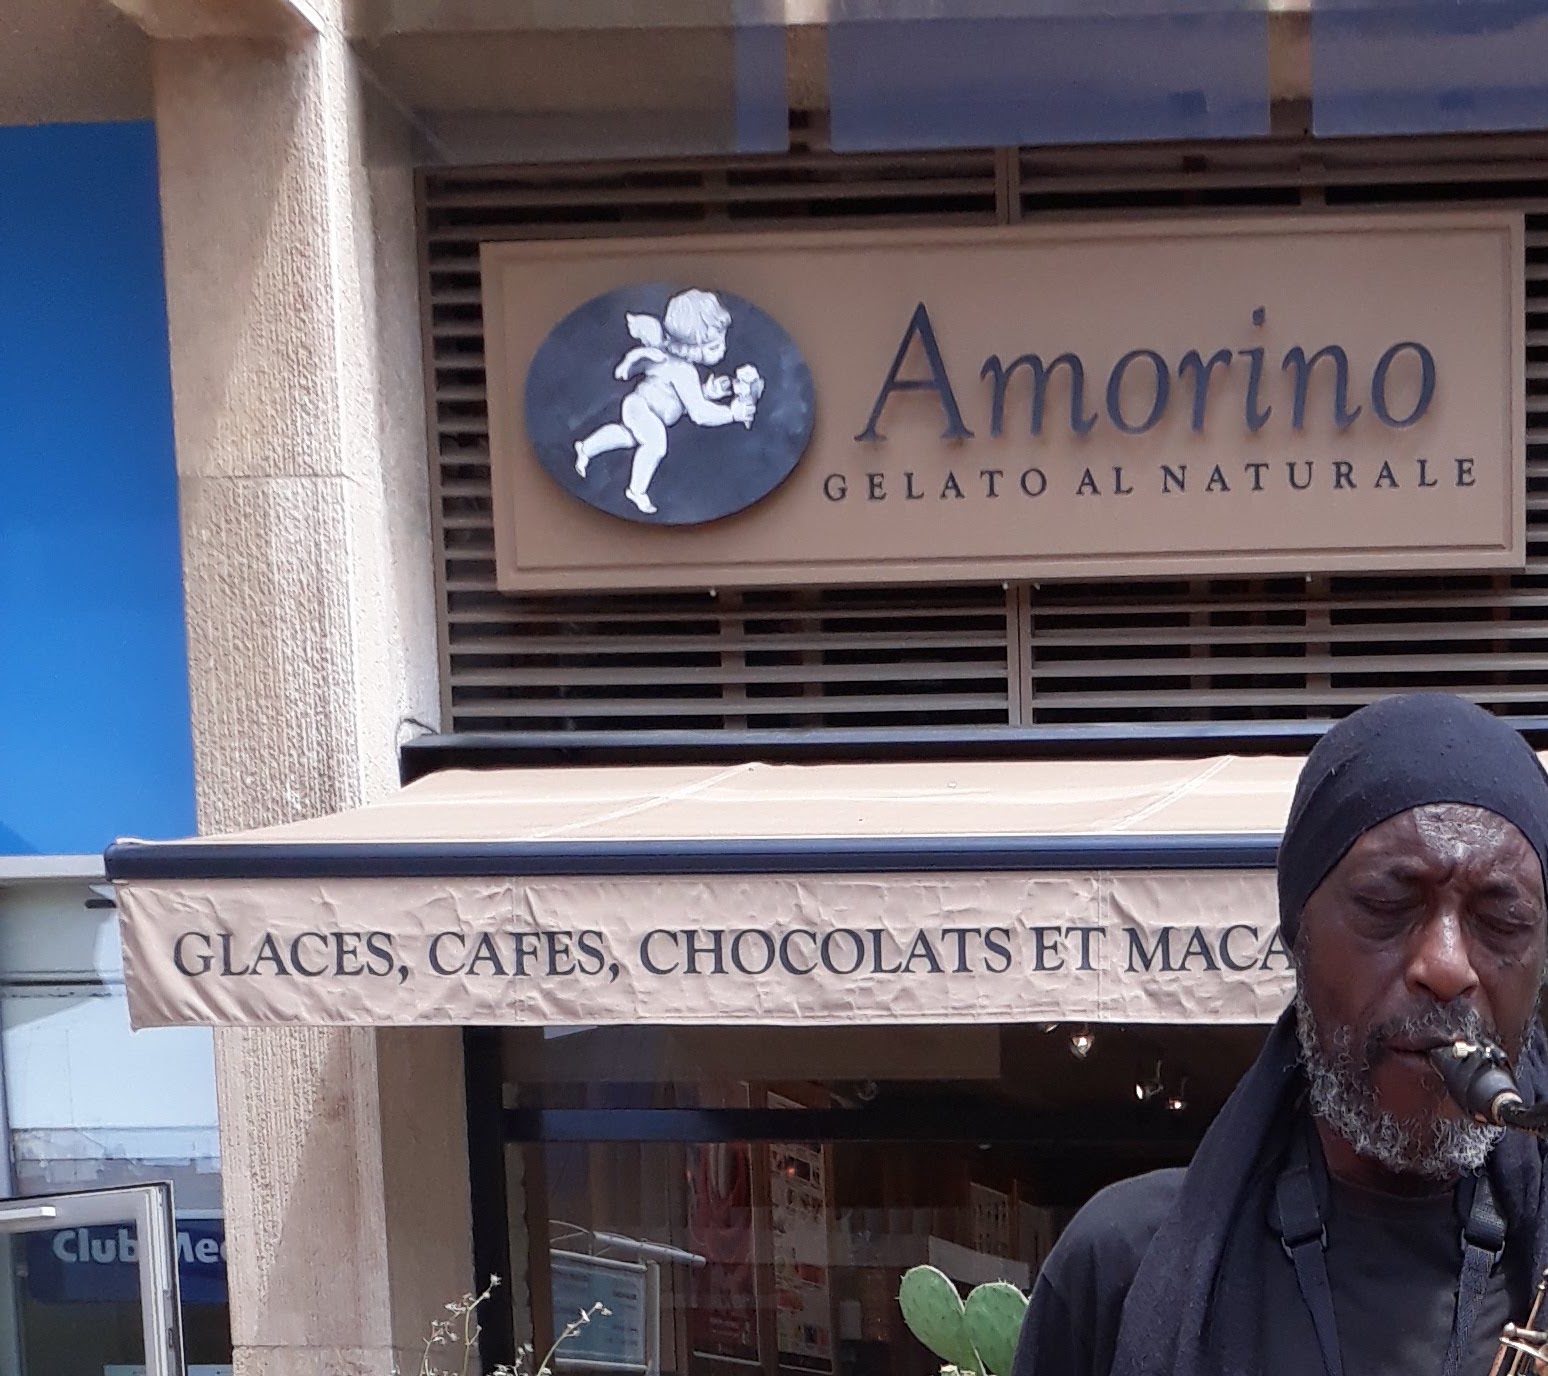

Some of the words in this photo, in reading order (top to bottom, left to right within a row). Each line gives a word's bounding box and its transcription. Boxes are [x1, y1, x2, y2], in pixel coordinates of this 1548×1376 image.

[853, 301, 1436, 442] Amorino
[823, 468, 1048, 501] GELATO
[1075, 466, 1134, 497] AL
[1160, 458, 1476, 494] NATURALE
[173, 930, 410, 985] GLACES,
[428, 928, 620, 984] CAFES,
[639, 926, 1012, 976] CHOCOLATS
[1028, 925, 1107, 973] ET
[53, 1228, 139, 1263] Club
